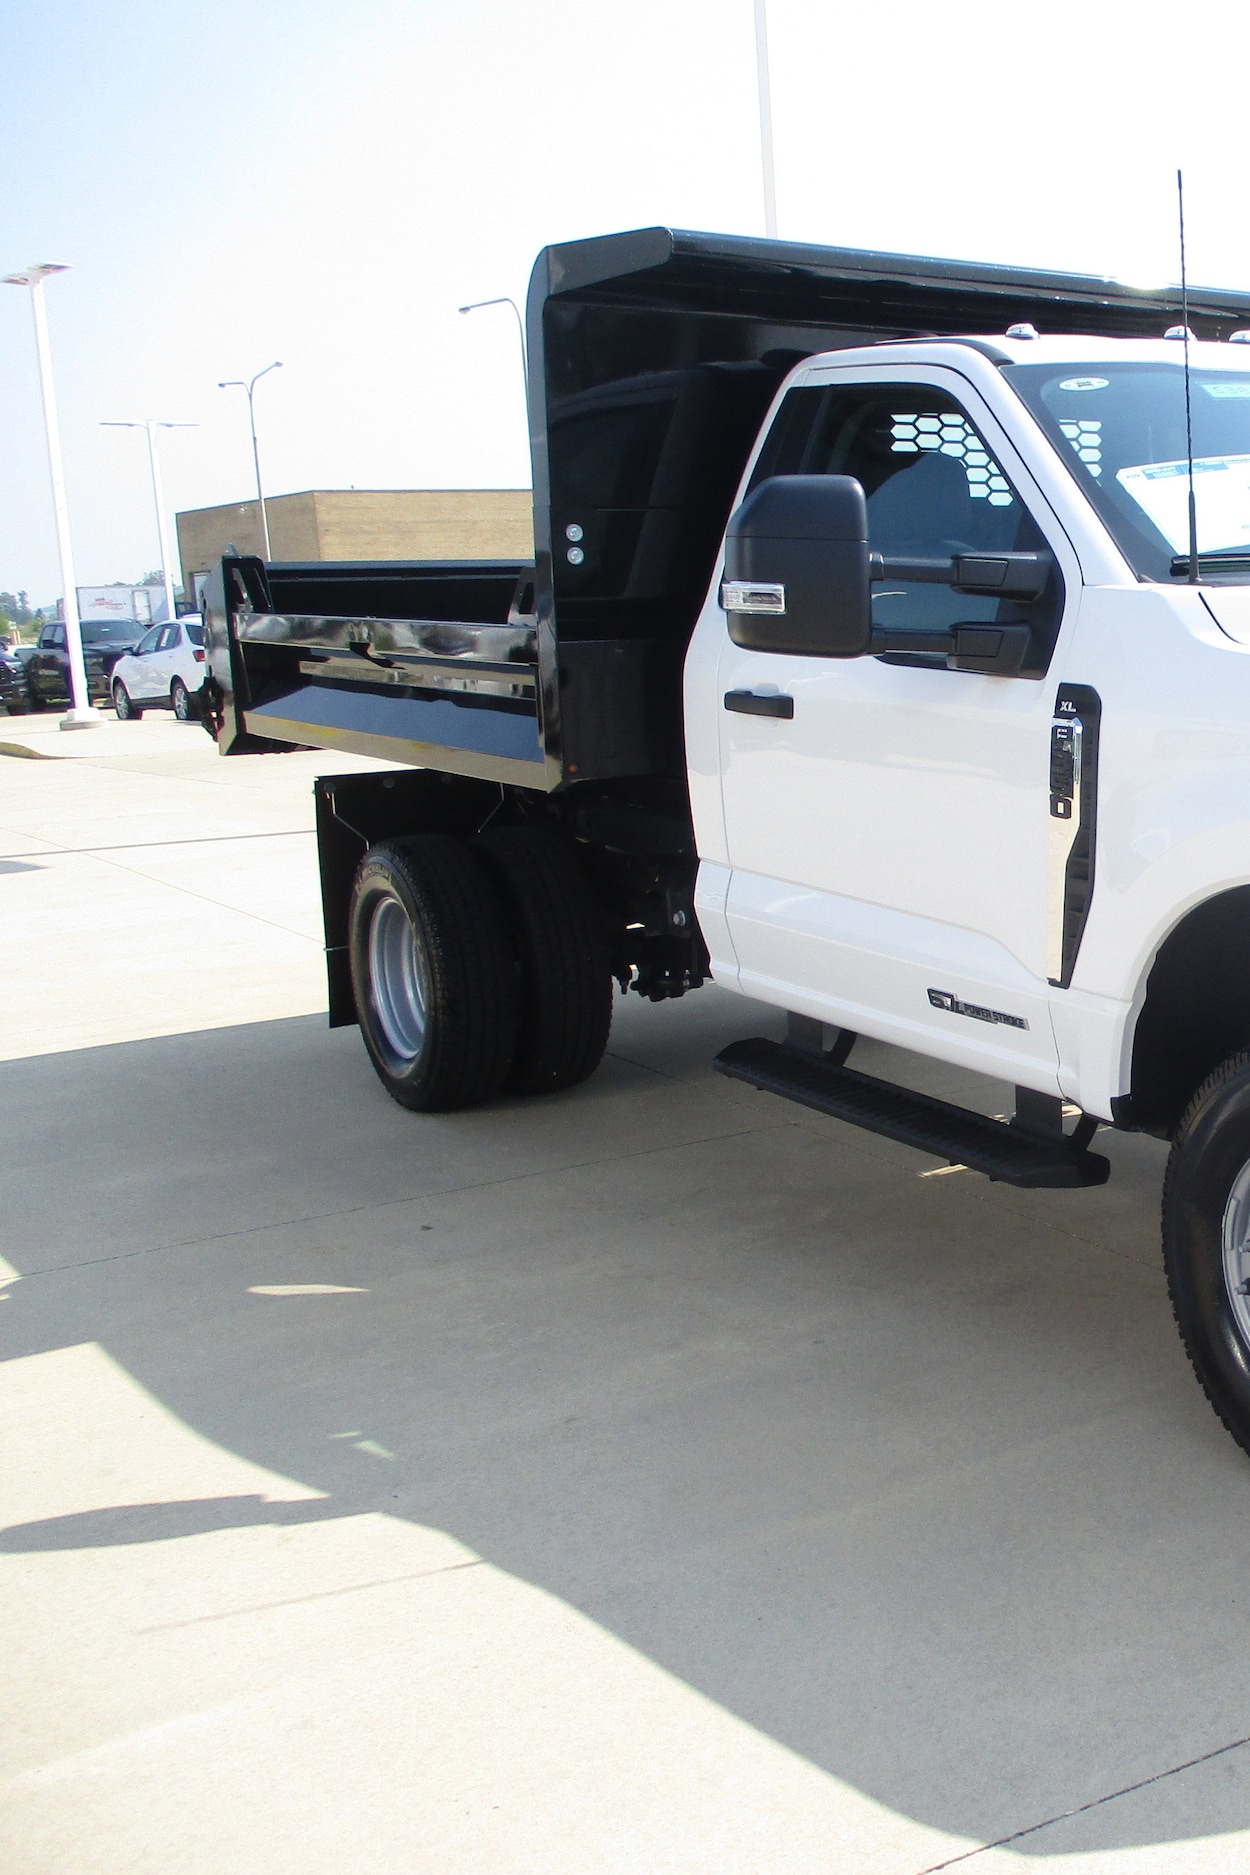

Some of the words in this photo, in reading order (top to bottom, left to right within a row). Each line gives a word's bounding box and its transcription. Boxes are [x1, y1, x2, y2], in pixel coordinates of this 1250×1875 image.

[1060, 701, 1077, 712] XL
[964, 1003, 993, 1020] POWER
[992, 1011, 1026, 1029] STROKE
